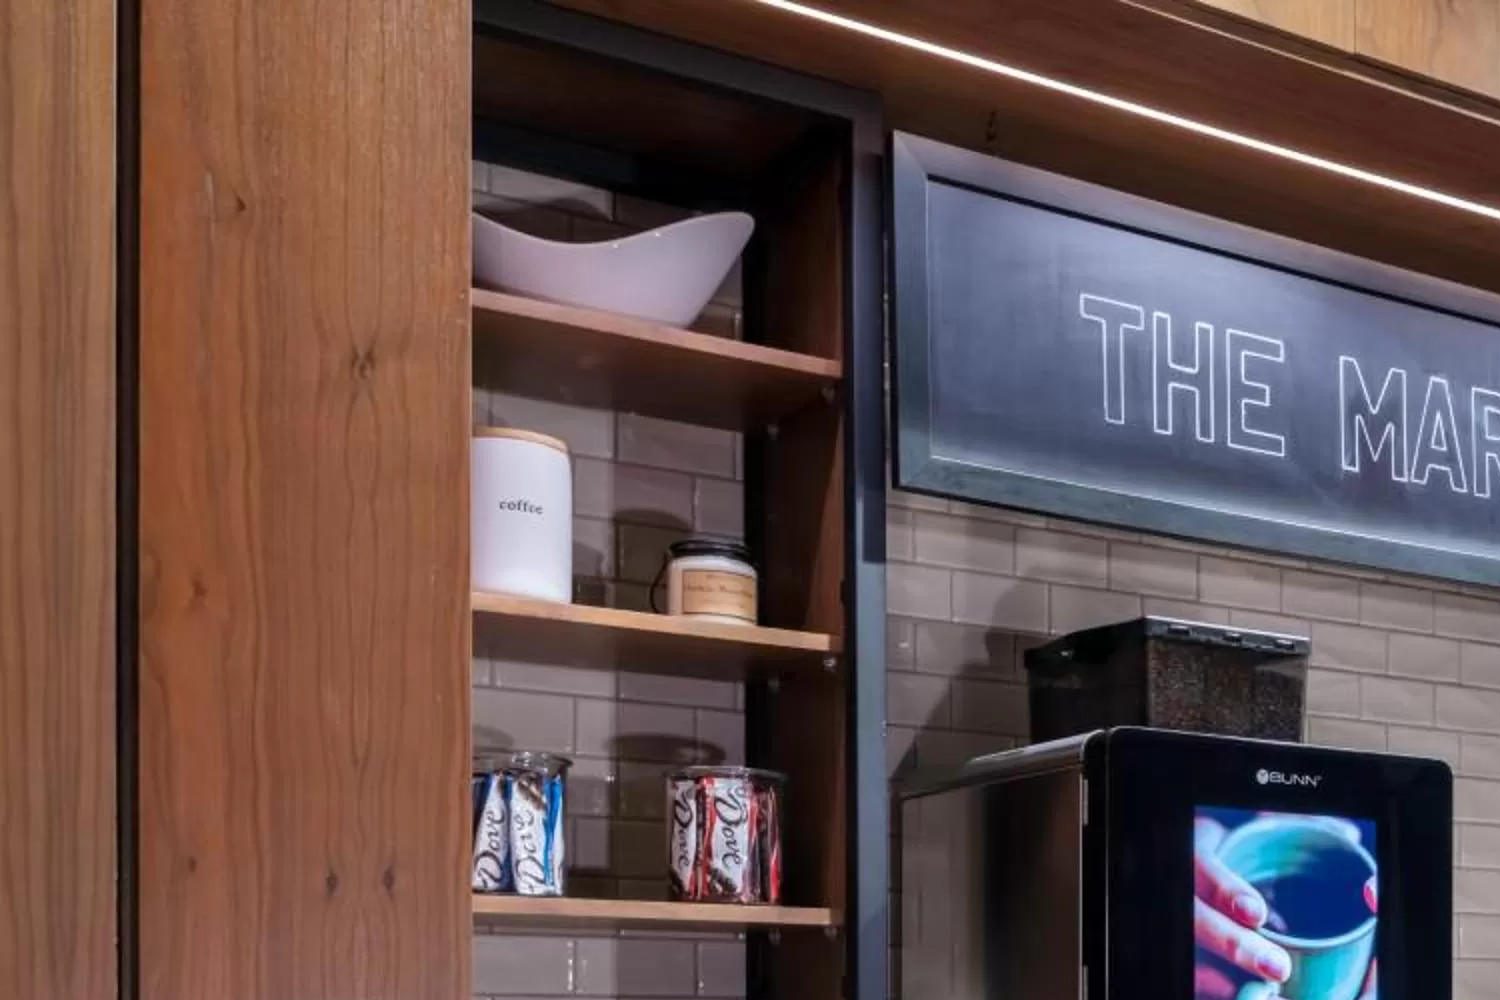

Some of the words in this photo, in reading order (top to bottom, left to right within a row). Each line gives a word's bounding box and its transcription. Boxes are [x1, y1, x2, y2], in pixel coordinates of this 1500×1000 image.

[1079, 292, 1286, 457] THE
[498, 499, 545, 515] coffee
[1269, 770, 1318, 788] BUNN
[714, 785, 748, 870] Dove
